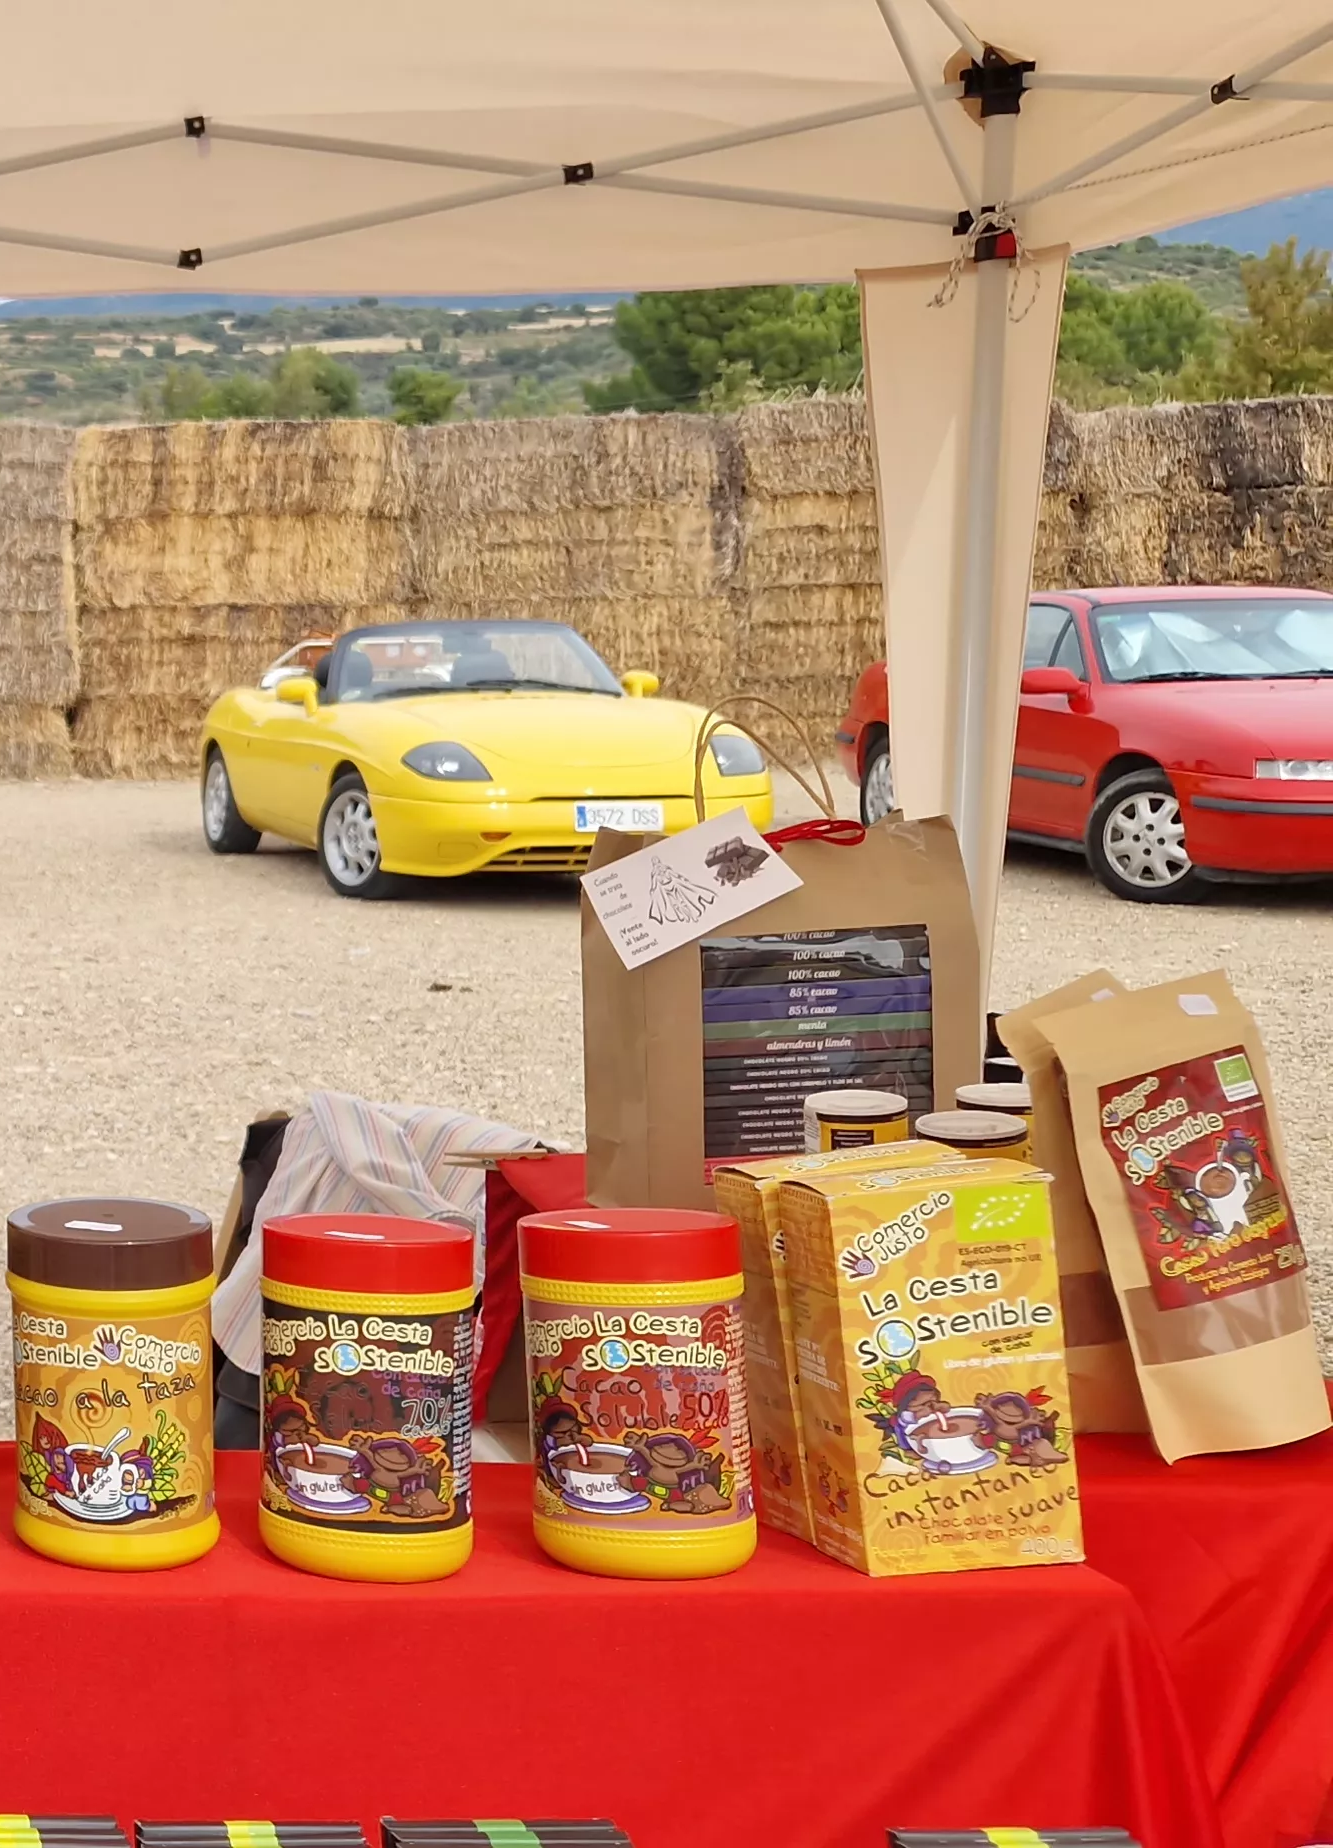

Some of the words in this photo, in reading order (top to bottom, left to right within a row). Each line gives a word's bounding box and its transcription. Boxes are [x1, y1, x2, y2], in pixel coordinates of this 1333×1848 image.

[588, 809, 623, 825] 3572
[633, 809, 658, 825] DSS
[594, 872, 618, 887] Cuando
[788, 970, 812, 980] 100%
[814, 969, 840, 978] cacao
[790, 988, 809, 997] 85%
[811, 988, 837, 996] cacao
[789, 1006, 808, 1015] 85%
[811, 1006, 837, 1014] cacao
[798, 1022, 827, 1030] menta
[767, 1040, 816, 1050] almendras
[817, 1041, 823, 1050] y
[825, 1038, 851, 1047] limón
[1113, 1128, 1134, 1147] La
[1138, 1099, 1185, 1130] Cesta
[857, 1192, 950, 1253] Comercio
[879, 1226, 926, 1261] Justo
[863, 1293, 898, 1317] La
[910, 1272, 997, 1301] Cesta
[21, 1316, 65, 1336] Cesta
[329, 1315, 356, 1337] La
[366, 1320, 430, 1342] Cesta
[596, 1313, 622, 1333] La
[633, 1315, 699, 1333] Cesta
[121, 1328, 200, 1361] Comercio
[128, 1352, 174, 1373] Justo
[382, 1382, 400, 1397] de
[406, 1381, 441, 1398] caña
[561, 1366, 643, 1395] Cacao
[76, 1393, 92, 1409] a
[102, 1378, 130, 1408] la
[138, 1375, 195, 1402] taza
[401, 1395, 453, 1427] 70%
[683, 1389, 729, 1420] 50%
[579, 1401, 679, 1431] Soluble
[401, 1424, 450, 1437] cacao
[310, 1482, 344, 1495] gluten
[1007, 1486, 1079, 1523] suave
[985, 1528, 1004, 1538] en
